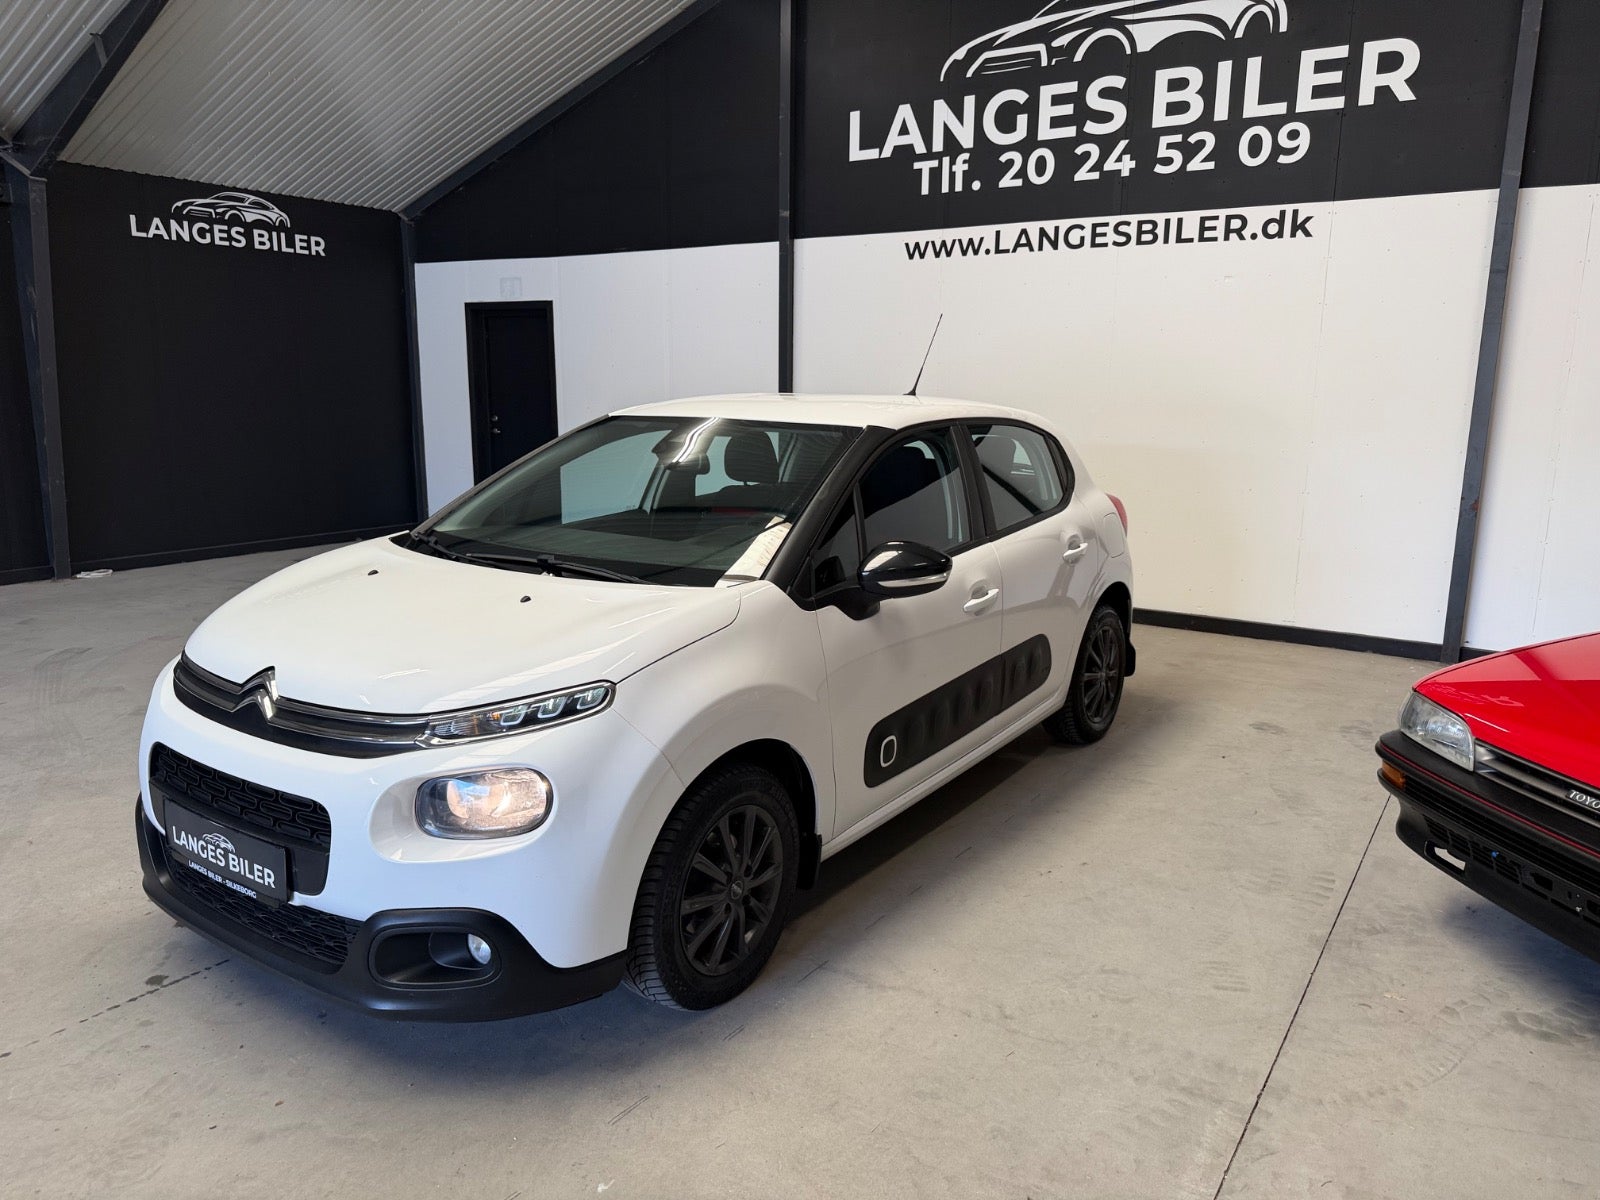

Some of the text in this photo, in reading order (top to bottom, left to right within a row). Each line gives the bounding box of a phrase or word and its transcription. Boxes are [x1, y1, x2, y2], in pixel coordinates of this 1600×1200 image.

[848, 37, 1421, 162] LANGES BILER
[913, 121, 1311, 196] Tlf. 20 24 52 09
[129, 214, 326, 257] LANGES BILER
[904, 208, 1314, 261] www.LANGESBILER.dk
[172, 825, 276, 889] LANGES BILER
[188, 860, 208, 875] LANGES
[207, 870, 223, 884] BILER
[225, 879, 257, 899] SILKEBORG
